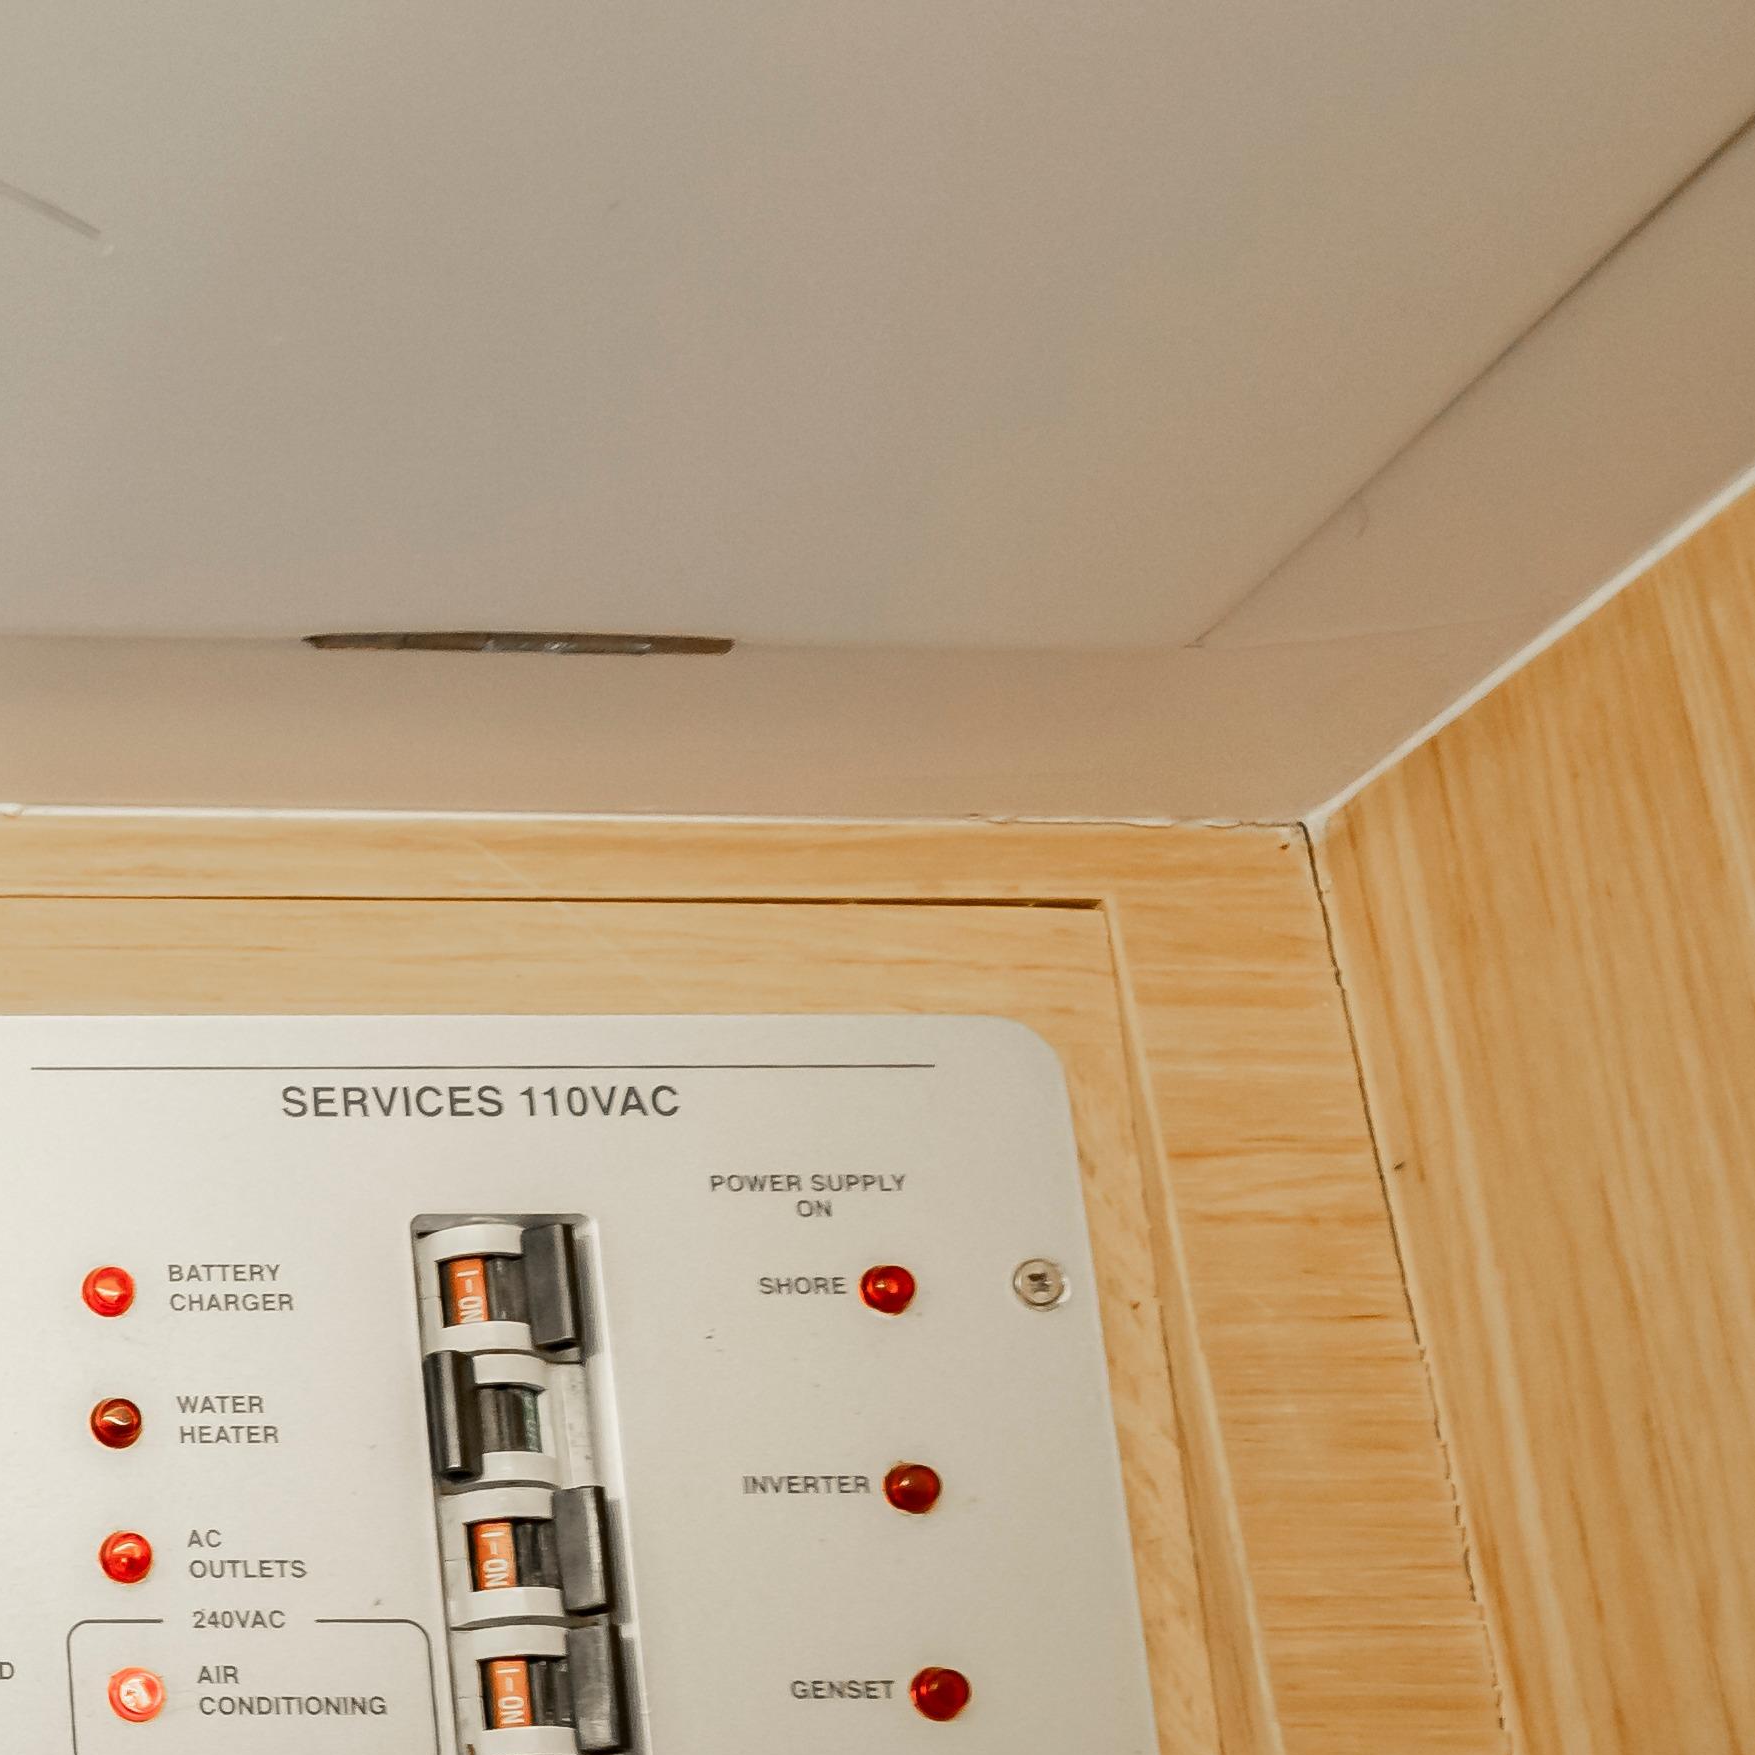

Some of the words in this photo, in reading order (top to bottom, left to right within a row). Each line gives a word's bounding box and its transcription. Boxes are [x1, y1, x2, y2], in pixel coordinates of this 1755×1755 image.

[281, 1085, 504, 1118] SERVICES
[519, 1084, 680, 1117] 110VAC
[709, 1174, 803, 1193] POWER
[810, 1173, 906, 1192] SUPPLY
[796, 1199, 833, 1218] ON
[167, 1263, 281, 1282] BATTERY
[759, 1276, 848, 1295] SHORE
[169, 1293, 294, 1312] CHARGER
[176, 1395, 264, 1414] WATER
[179, 1425, 279, 1444] HEATER
[742, 1475, 871, 1494] INVERTER
[187, 1529, 222, 1548] AC
[188, 1559, 308, 1579] OUTLETS
[192, 1609, 286, 1629] 240VAC
[196, 1665, 240, 1685] AIR
[790, 1679, 896, 1700] GENSET
[198, 1695, 388, 1716] CONDITIONING
